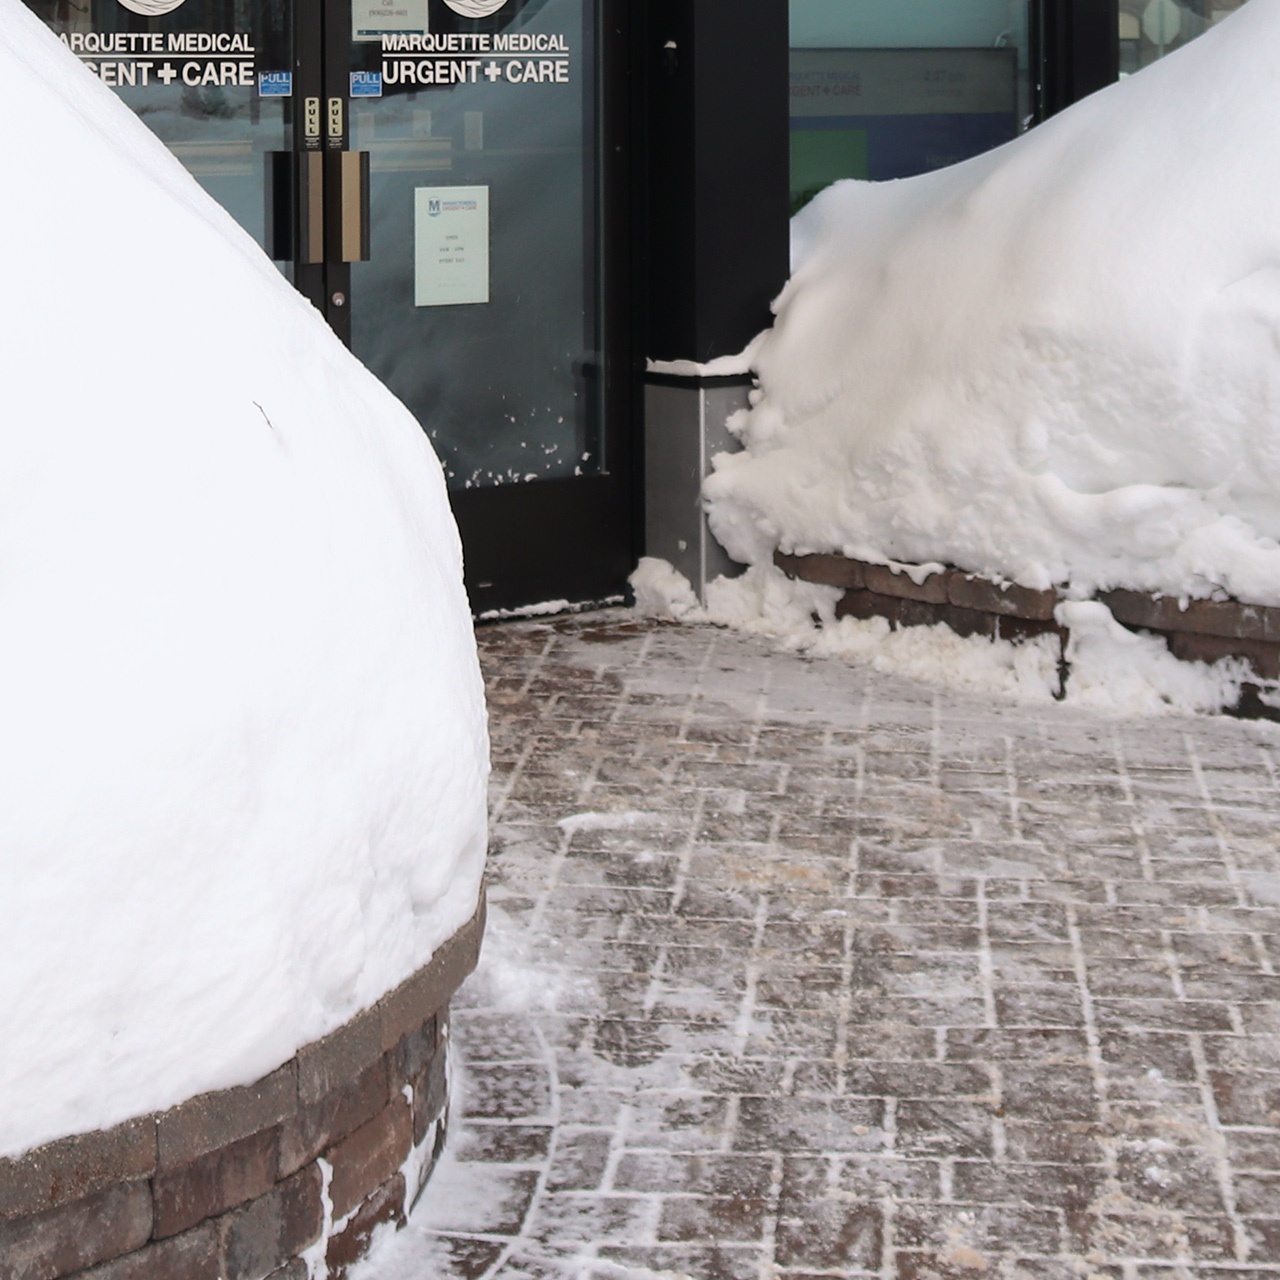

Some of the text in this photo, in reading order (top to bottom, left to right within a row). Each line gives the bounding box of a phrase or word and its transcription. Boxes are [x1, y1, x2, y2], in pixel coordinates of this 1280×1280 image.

[168, 33, 255, 52] MEDICAL
[381, 34, 569, 52] MARQUETTE MEDICAL
[182, 62, 255, 86] CARE
[352, 73, 380, 84] PULL
[382, 60, 482, 84] URGENT
[506, 60, 569, 84] CARE
[308, 100, 316, 134] PULL
[331, 100, 339, 134] PULL
